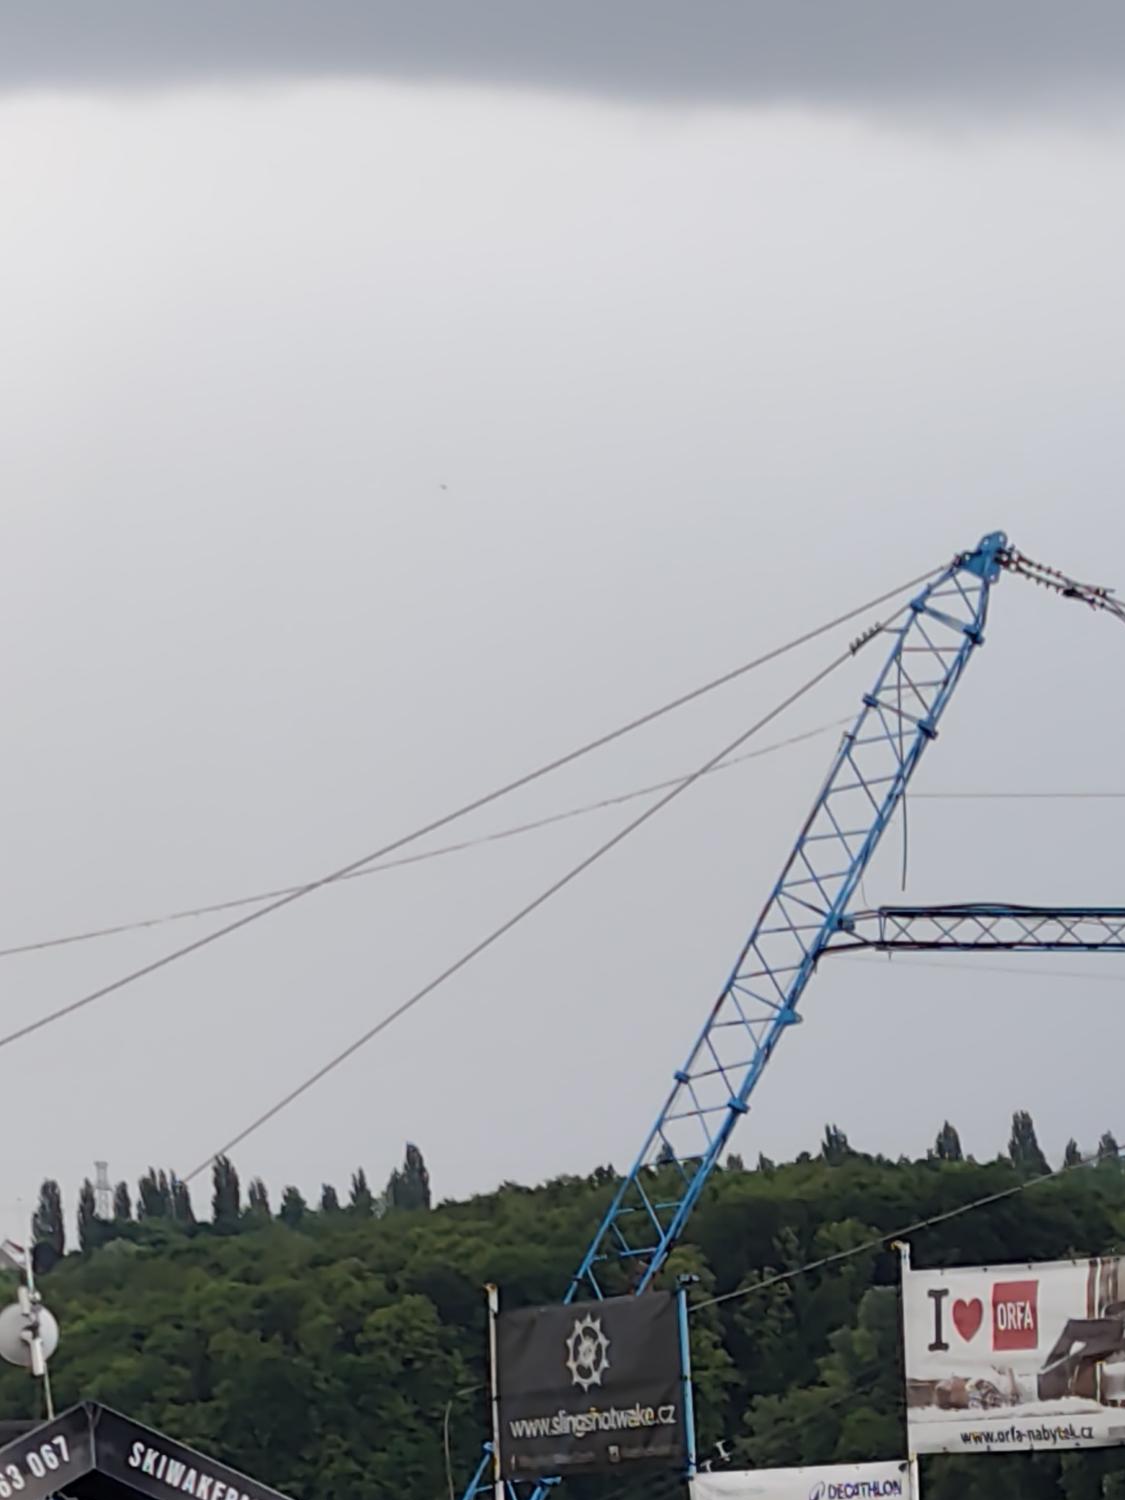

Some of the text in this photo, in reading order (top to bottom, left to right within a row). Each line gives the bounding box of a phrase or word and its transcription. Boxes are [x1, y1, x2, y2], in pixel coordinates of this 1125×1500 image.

[927, 1288, 1034, 1351] I ORFA
[509, 1402, 677, 1438] www.slingshotwake.cz
[960, 1424, 1094, 1445] www.orfa-nabytek.cz
[26, 1434, 70, 1478] 067
[828, 1480, 902, 1500] DECATHLON
